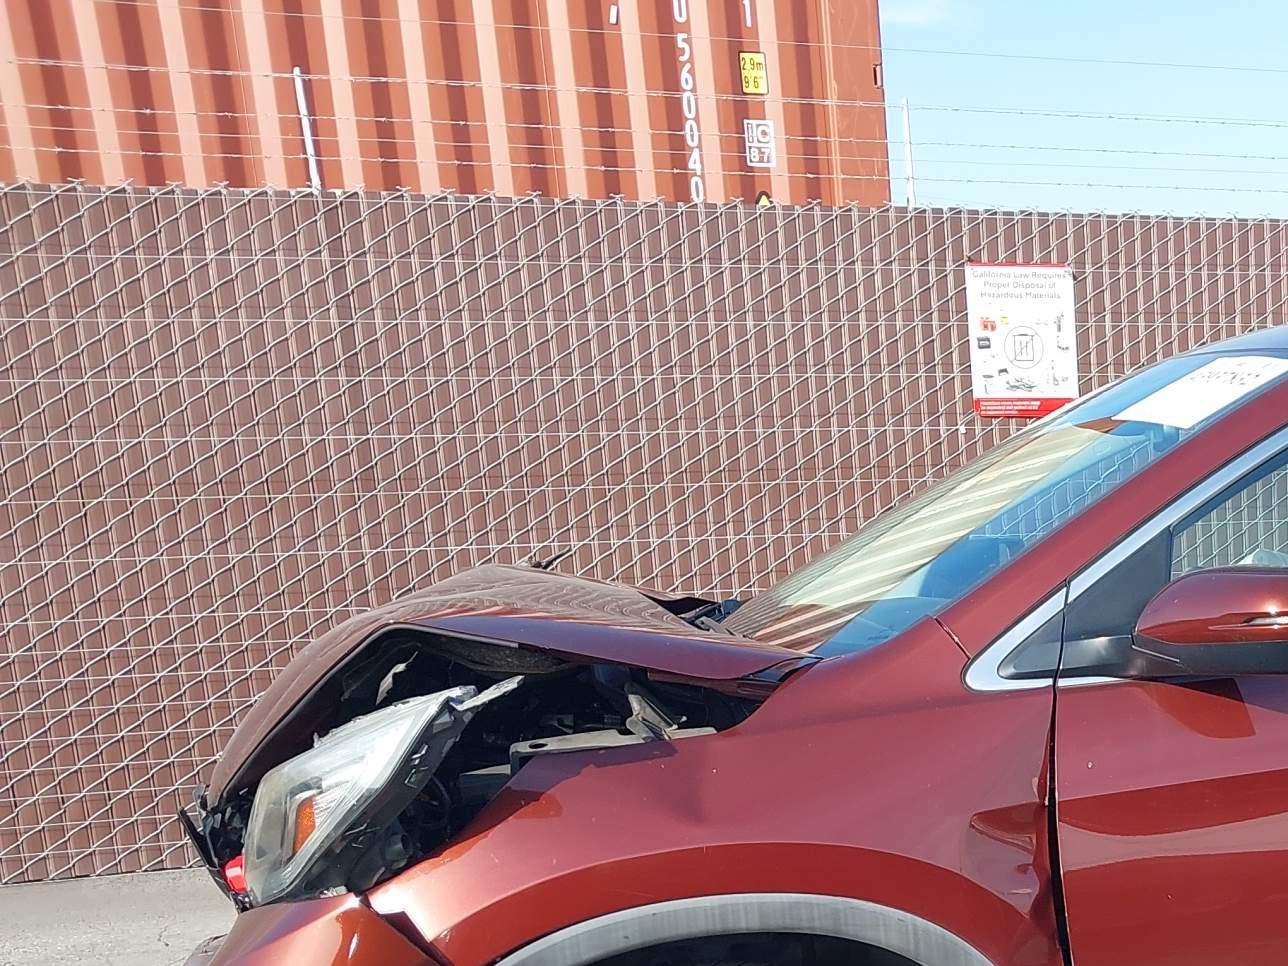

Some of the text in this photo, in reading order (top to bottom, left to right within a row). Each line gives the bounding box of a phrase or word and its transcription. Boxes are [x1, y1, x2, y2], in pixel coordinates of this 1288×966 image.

[972, 270, 1066, 281] California Law Requires
[983, 281, 1056, 290] Proper Disposal of
[980, 291, 1061, 300] Hazardous Materials
